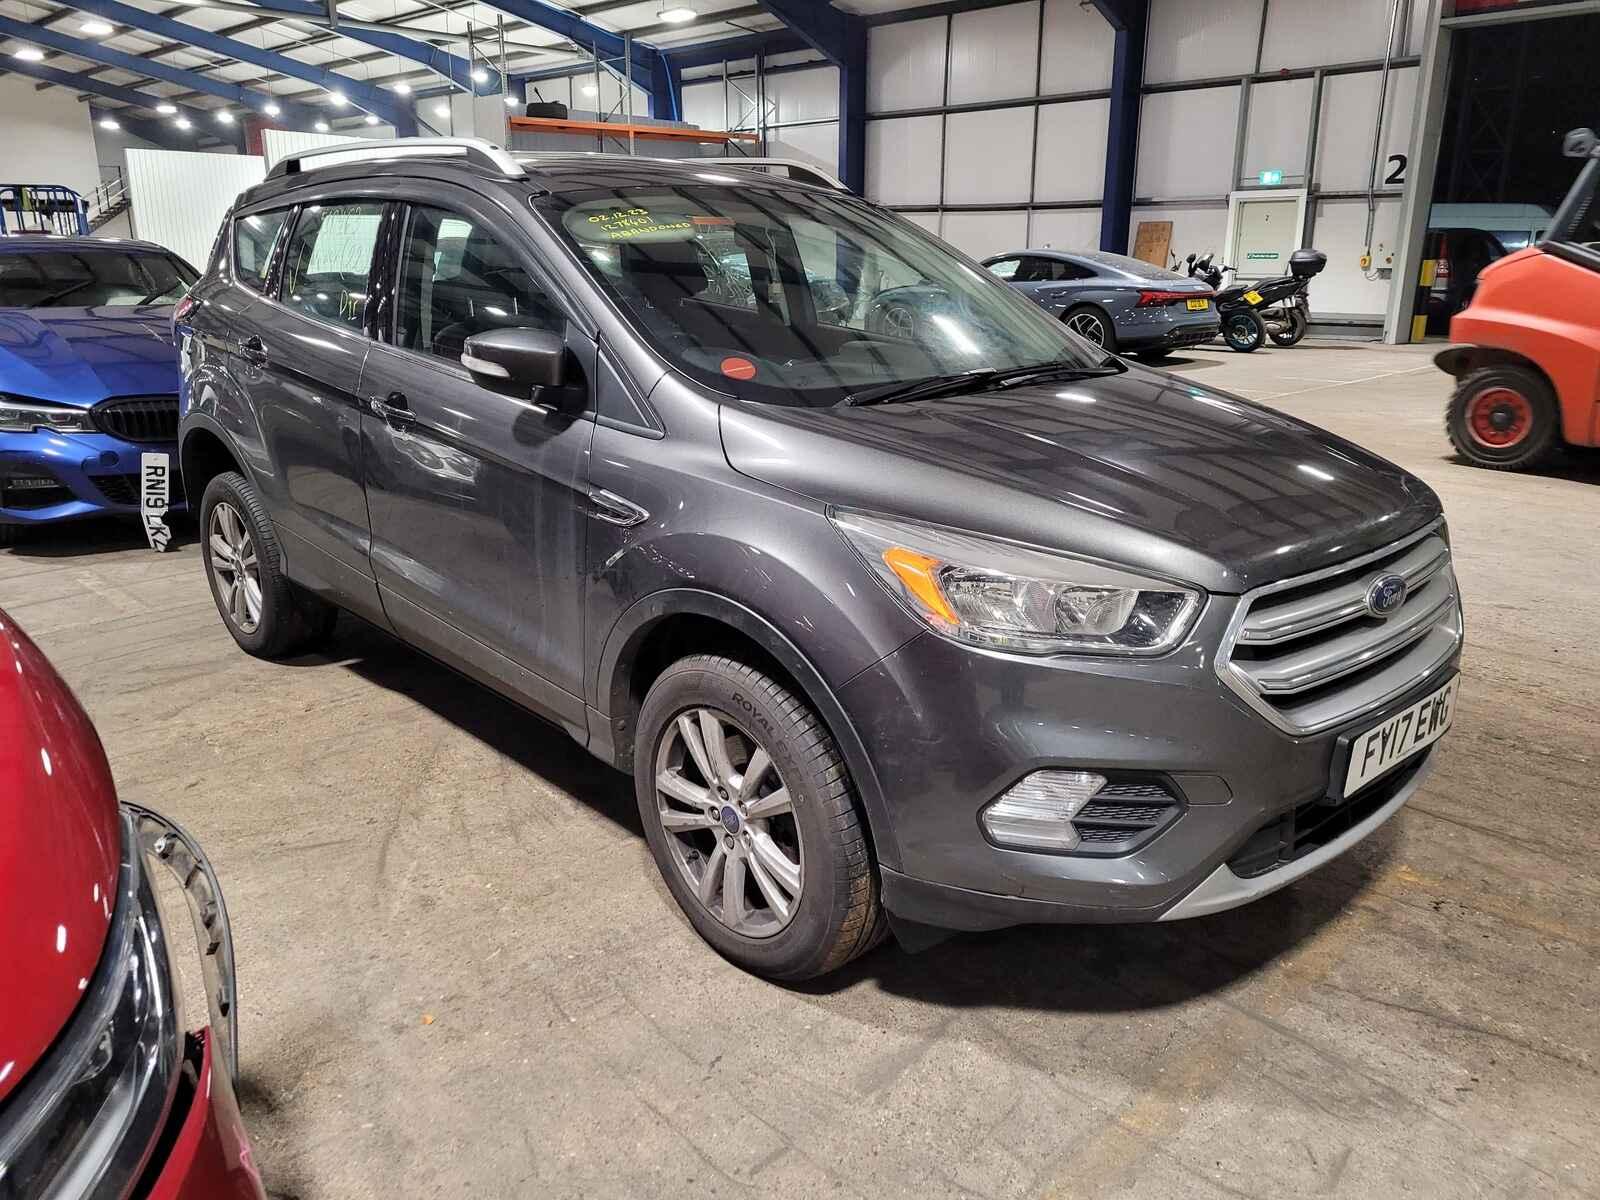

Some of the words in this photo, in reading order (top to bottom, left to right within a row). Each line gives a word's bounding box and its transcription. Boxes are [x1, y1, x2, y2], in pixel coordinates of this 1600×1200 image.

[1384, 154, 1408, 185] 2
[588, 208, 648, 223] 02.12.23
[145, 465, 167, 509] RN19
[1382, 585, 1403, 608] Ford
[732, 692, 775, 736] ROYAL
[1360, 711, 1414, 778] FY17
[1414, 689, 1451, 742] EWG
